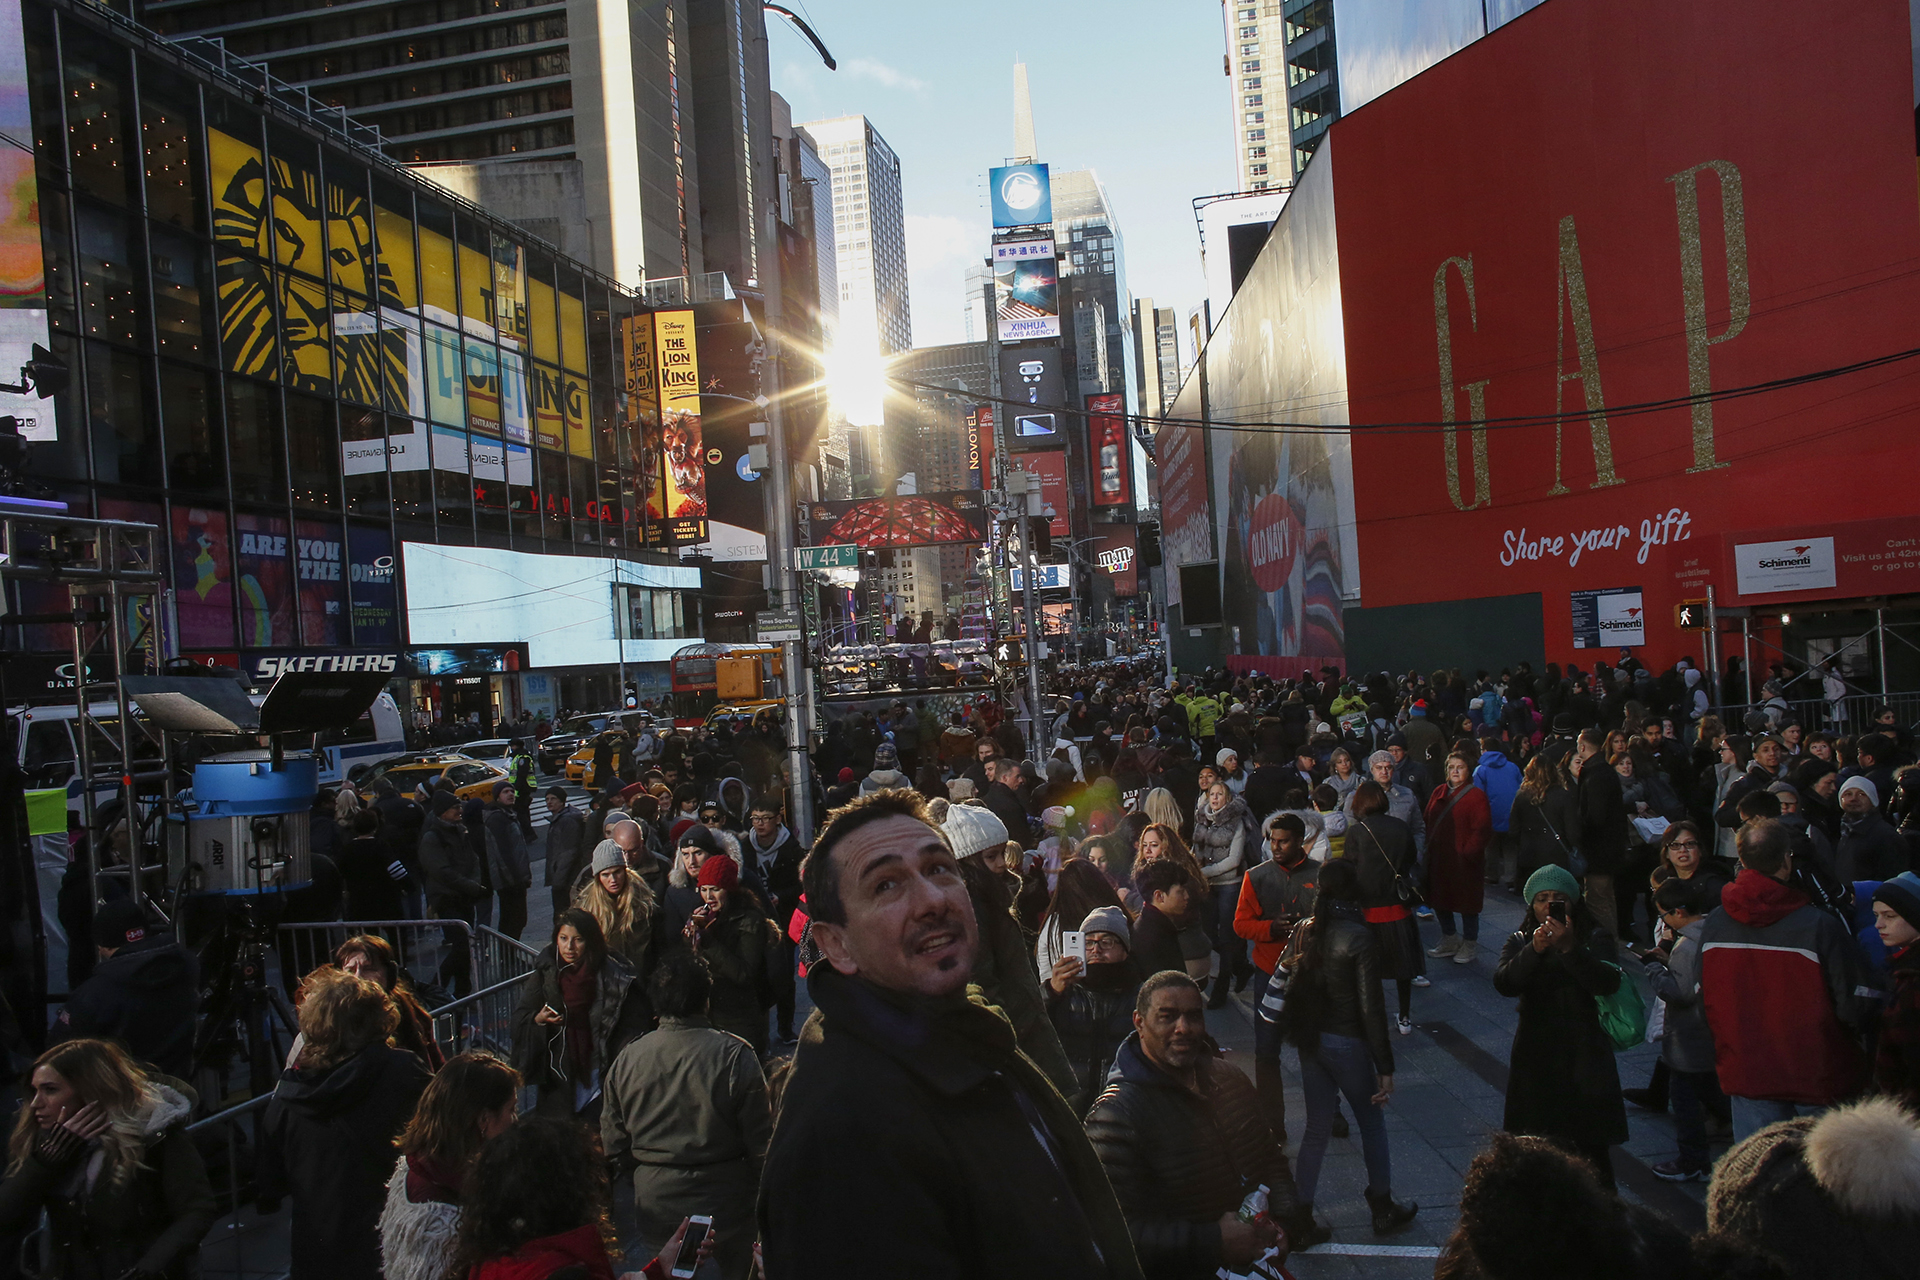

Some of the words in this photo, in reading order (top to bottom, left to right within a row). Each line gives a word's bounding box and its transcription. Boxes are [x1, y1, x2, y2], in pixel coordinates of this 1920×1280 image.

[998, 245, 1049, 257] 新华通讯社
[662, 322, 685, 330] Disney
[1003, 330, 1025, 338] NEWS
[1025, 328, 1056, 337] AGENCY
[1011, 321, 1047, 331] XINHUA
[665, 338, 685, 348] THE
[1433, 159, 1751, 511] GAP
[662, 351, 690, 367] LION
[661, 368, 696, 387] KING
[472, 416, 500, 431] ENTRANCE
[507, 425, 517, 434] ON
[538, 434, 554, 445] STREET
[968, 411, 981, 470] NOVOTEL
[240, 535, 287, 557] ARE
[298, 539, 340, 562] YOU
[1251, 530, 1266, 569] OLD
[1266, 517, 1290, 562] NAVY
[1500, 527, 1564, 567] Share
[1569, 524, 1630, 568] your
[1886, 538, 1916, 548] Can't
[802, 550, 814, 567] W
[819, 548, 839, 566] 44
[845, 547, 854, 557] ST
[1759, 556, 1811, 569] Schimenti
[1842, 553, 1866, 563] Visit
[1868, 553, 1882, 561] us
[1884, 551, 1896, 559] at
[299, 560, 341, 582] THE
[1886, 562, 1901, 572] go
[1903, 561, 1915, 569] to
[714, 610, 740, 618] swatch
[1600, 619, 1642, 629] Schimenti
[254, 654, 398, 679] SKECHERS
[212, 839, 224, 865] ARRI
